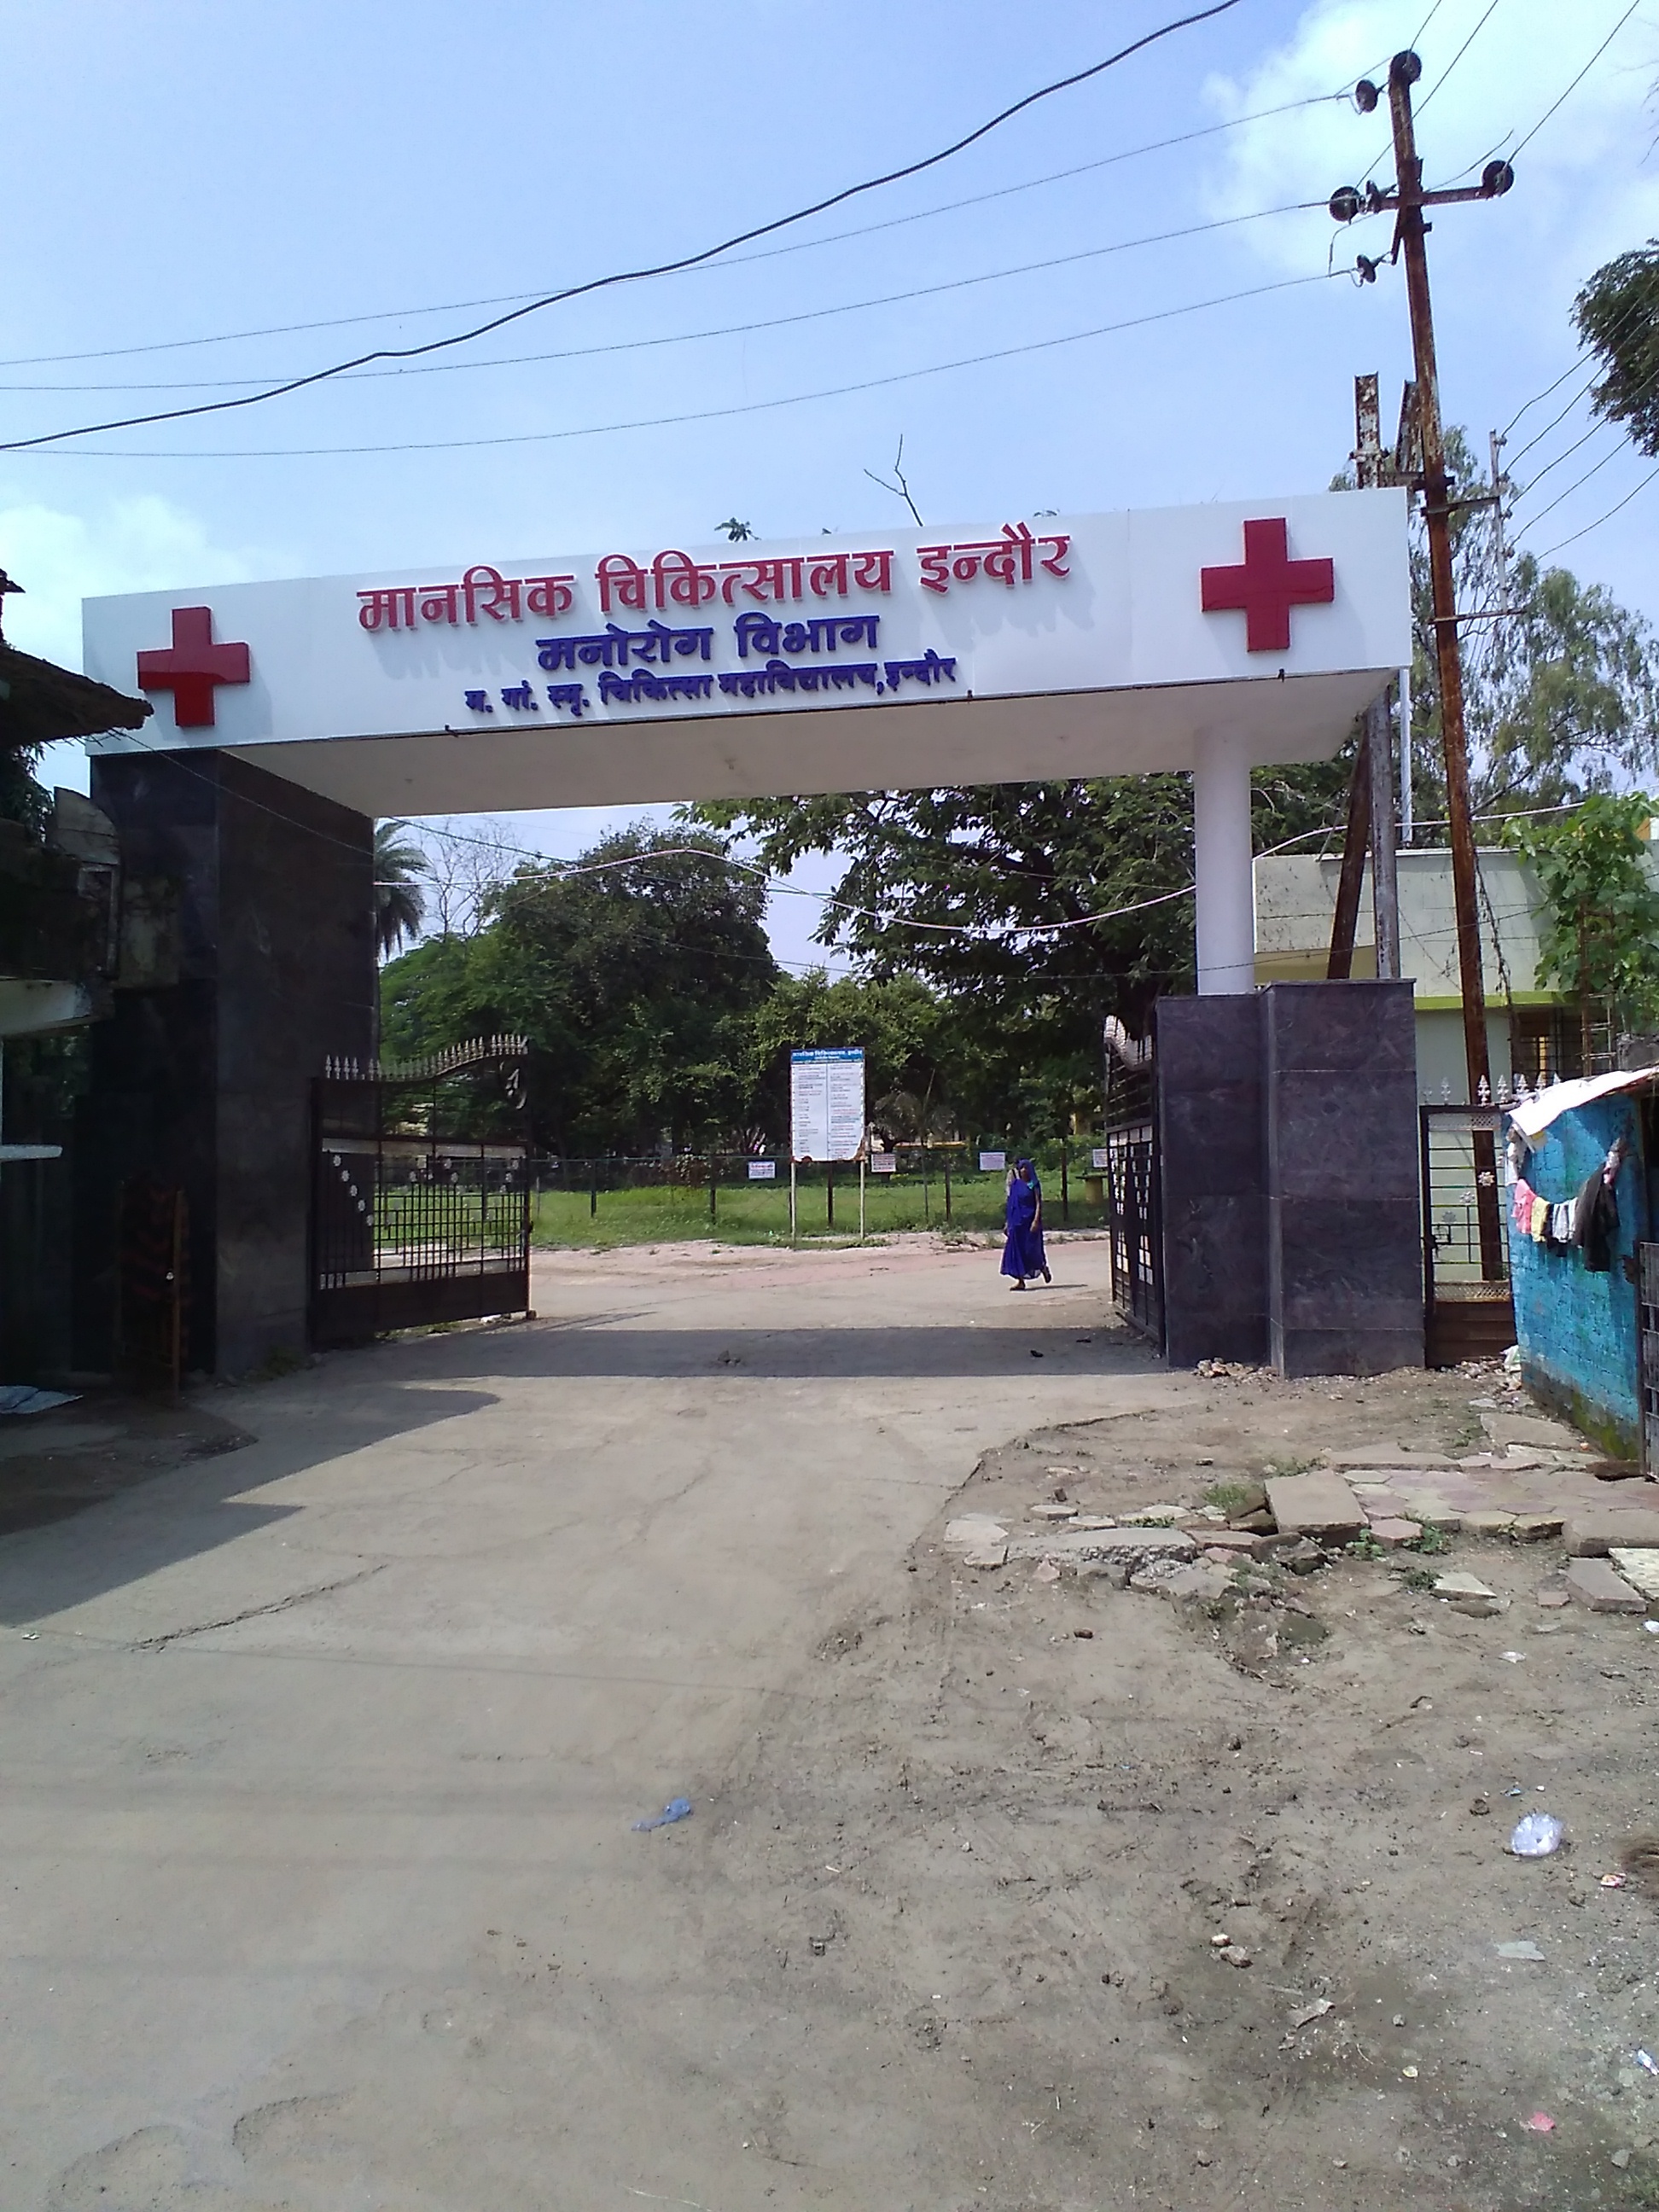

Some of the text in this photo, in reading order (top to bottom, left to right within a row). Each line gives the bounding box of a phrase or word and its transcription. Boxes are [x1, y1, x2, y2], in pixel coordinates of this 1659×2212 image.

[356, 521, 1071, 630] मानसिक चिकित्सालय इन्दौर
[535, 611, 881, 672] मनोरोग विभाग
[597, 668, 714, 706] चिकित्सा
